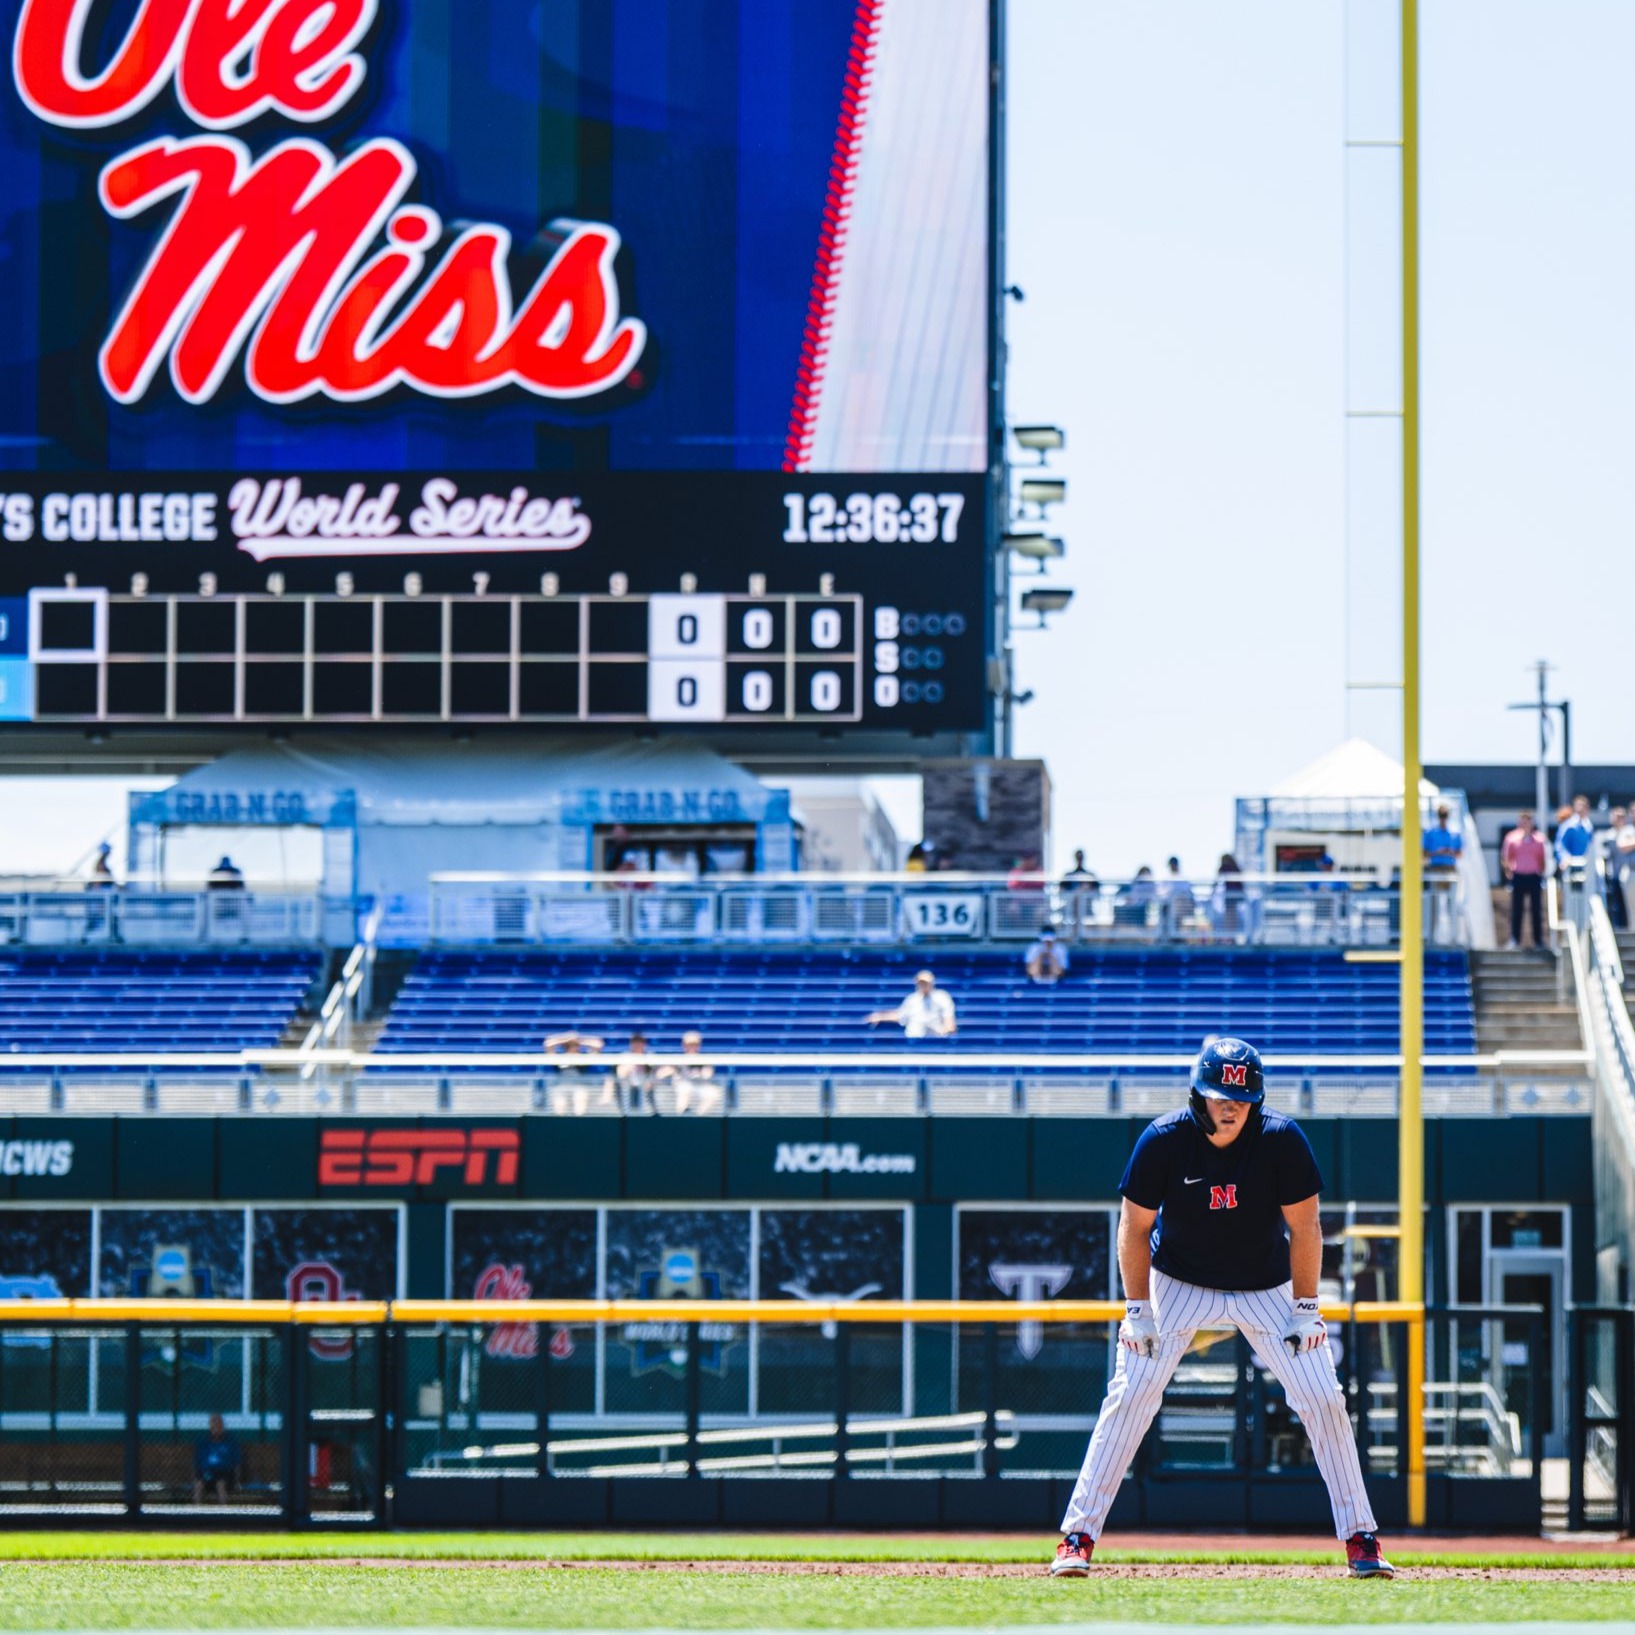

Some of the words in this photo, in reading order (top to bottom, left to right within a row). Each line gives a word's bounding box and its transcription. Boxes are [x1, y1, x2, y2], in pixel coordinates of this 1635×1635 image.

[99, 135, 648, 404] Miss
[42, 493, 218, 542] COLLEGE
[228, 477, 401, 538] World
[409, 477, 577, 538] Series
[783, 493, 965, 543] 12:36:37
[64, 572, 77, 588] 1
[131, 572, 148, 597] 2
[199, 572, 217, 597] 3
[266, 572, 284, 597] 4
[336, 572, 354, 597] 5
[404, 572, 422, 597] 6
[473, 572, 490, 597] 7
[541, 572, 559, 597] 8
[609, 572, 628, 597] 9
[678, 614, 698, 645] 0
[742, 608, 773, 649] 0
[811, 608, 841, 649] 0
[874, 607, 900, 640] B
[874, 641, 900, 673] S
[677, 677, 697, 707] 0
[742, 671, 773, 711] 0
[811, 671, 841, 711] 0
[918, 904, 968, 925] 136
[1222, 1064, 1246, 1085] M
[0, 1140, 73, 1175] CWS
[319, 1130, 520, 1184] ESPN
[774, 1143, 916, 1173] NCAA.com
[1209, 1184, 1238, 1209] M
